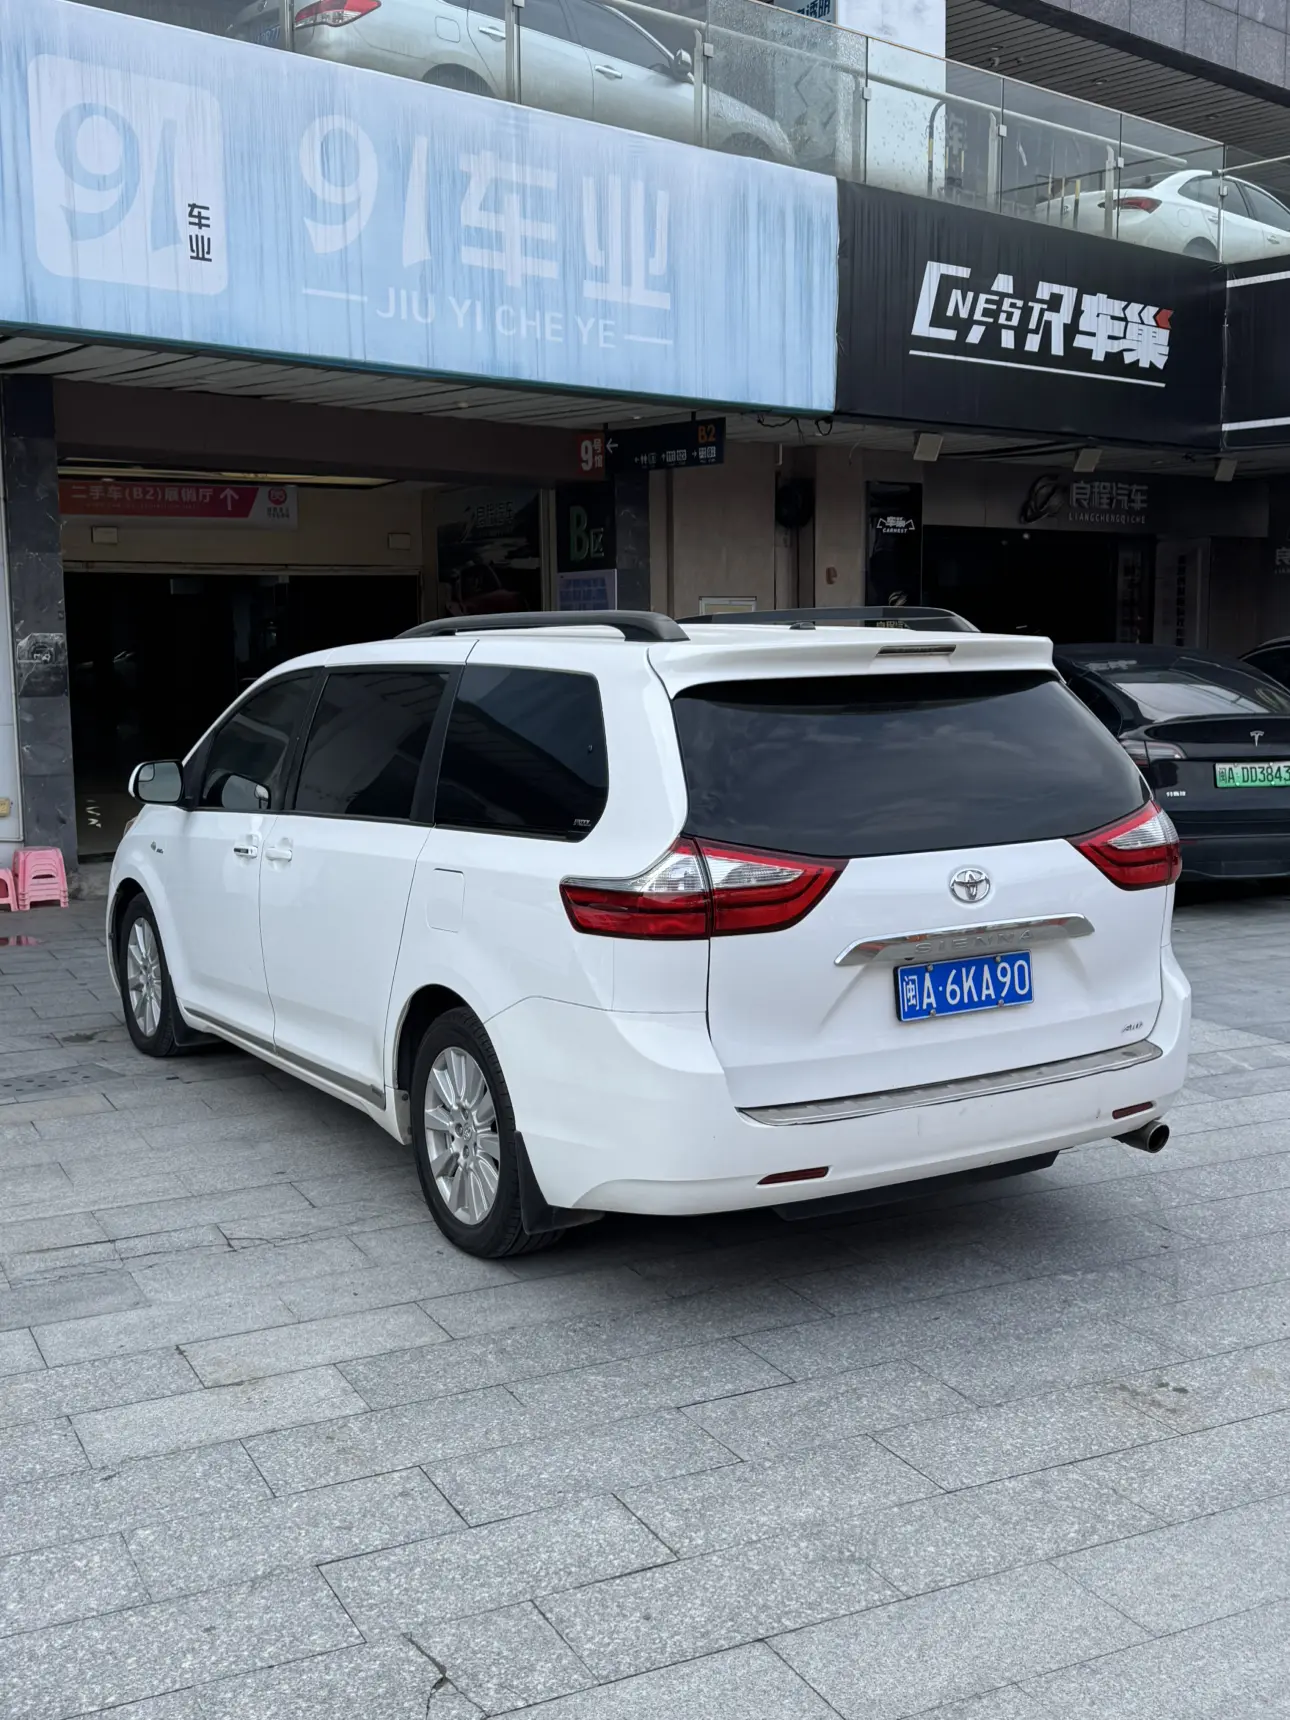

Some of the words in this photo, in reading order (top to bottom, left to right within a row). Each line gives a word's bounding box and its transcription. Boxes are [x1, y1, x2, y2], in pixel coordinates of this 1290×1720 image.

[302, 115, 671, 310] 91车业
[187, 203, 212, 262] 车业
[376, 287, 435, 324] JIU
[448, 296, 483, 333] YI
[495, 305, 563, 343] CHE
[574, 314, 617, 349] YE
[946, 288, 1048, 330] NEST
[698, 423, 716, 444] B2
[580, 439, 594, 471] 9
[71, 484, 215, 504] 二手车(B2)展销厅
[1069, 481, 1149, 511] 良程汽车
[1068, 512, 1147, 525] LIANGCHENGQICHE
[914, 930, 1036, 954] SIENNA
[903, 959, 1030, 1012] 闽A·6KA90
